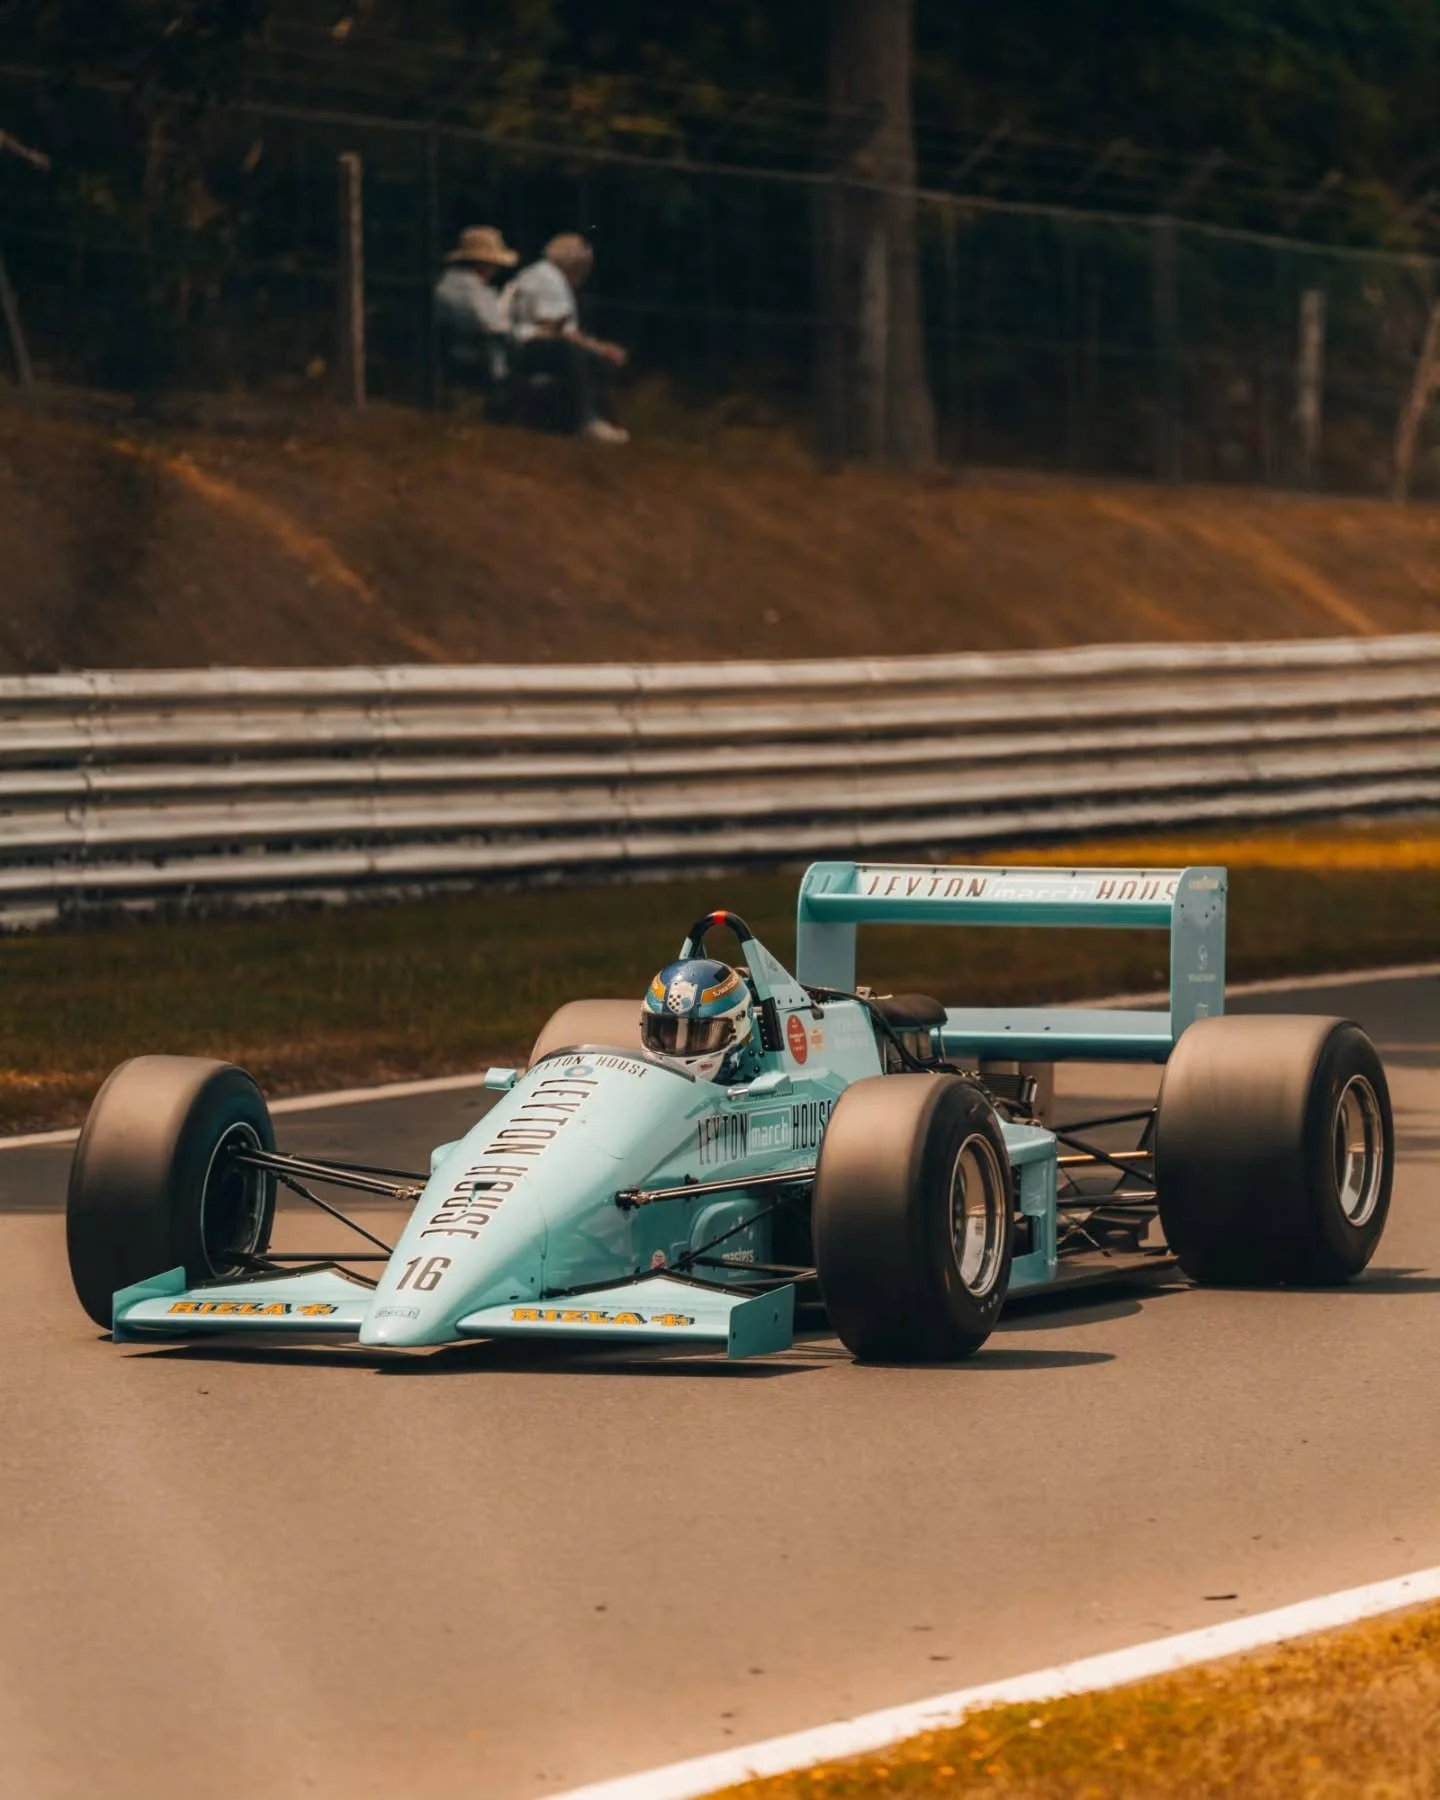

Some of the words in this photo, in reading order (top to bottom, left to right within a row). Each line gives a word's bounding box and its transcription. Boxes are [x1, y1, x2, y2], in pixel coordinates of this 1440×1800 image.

[1096, 880, 1178, 900] HOUS
[482, 1079, 599, 1156] LEYTON
[697, 1112, 747, 1166] LEYTON
[751, 1115, 789, 1149] march
[418, 1165, 529, 1240] HOUSE
[396, 1256, 451, 1291] 16
[167, 1302, 293, 1317] RIZLA
[512, 1309, 648, 1325] RIZLA
